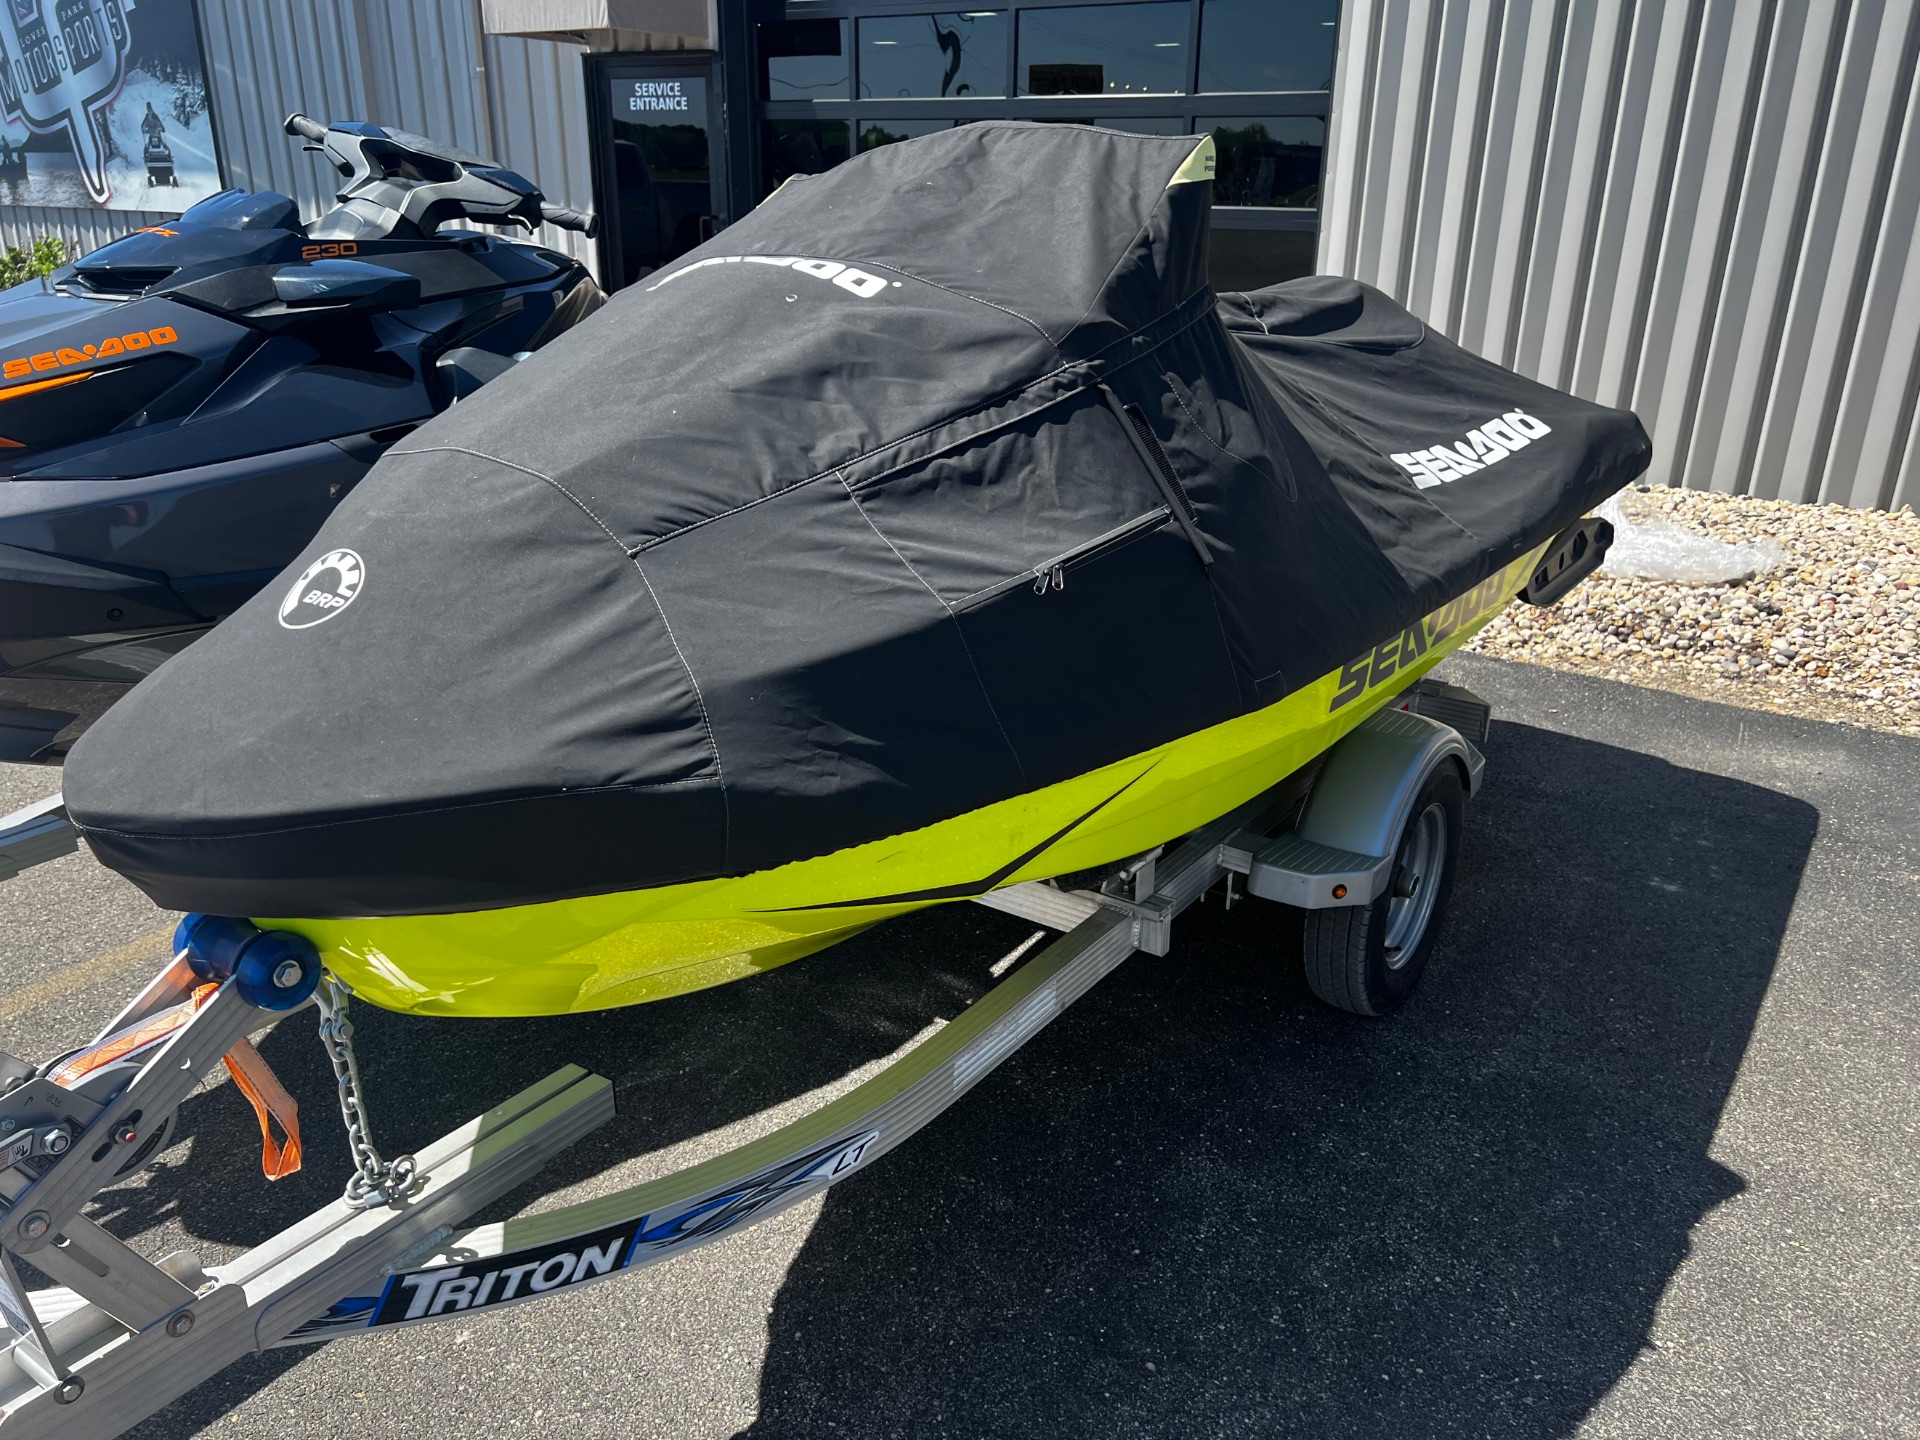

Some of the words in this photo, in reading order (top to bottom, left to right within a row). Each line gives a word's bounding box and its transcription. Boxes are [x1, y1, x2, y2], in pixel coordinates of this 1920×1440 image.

[20, 26, 46, 48] LOVES
[61, 2, 85, 21] PARK
[0, 1, 122, 105] MOTORSPORTS
[629, 97, 688, 110] ENTRANCE
[634, 82, 681, 96] SERVICE
[302, 242, 357, 259] 230
[302, 589, 346, 609] BRP
[832, 1135, 876, 1176] LT
[401, 1237, 625, 1320] TRITON
